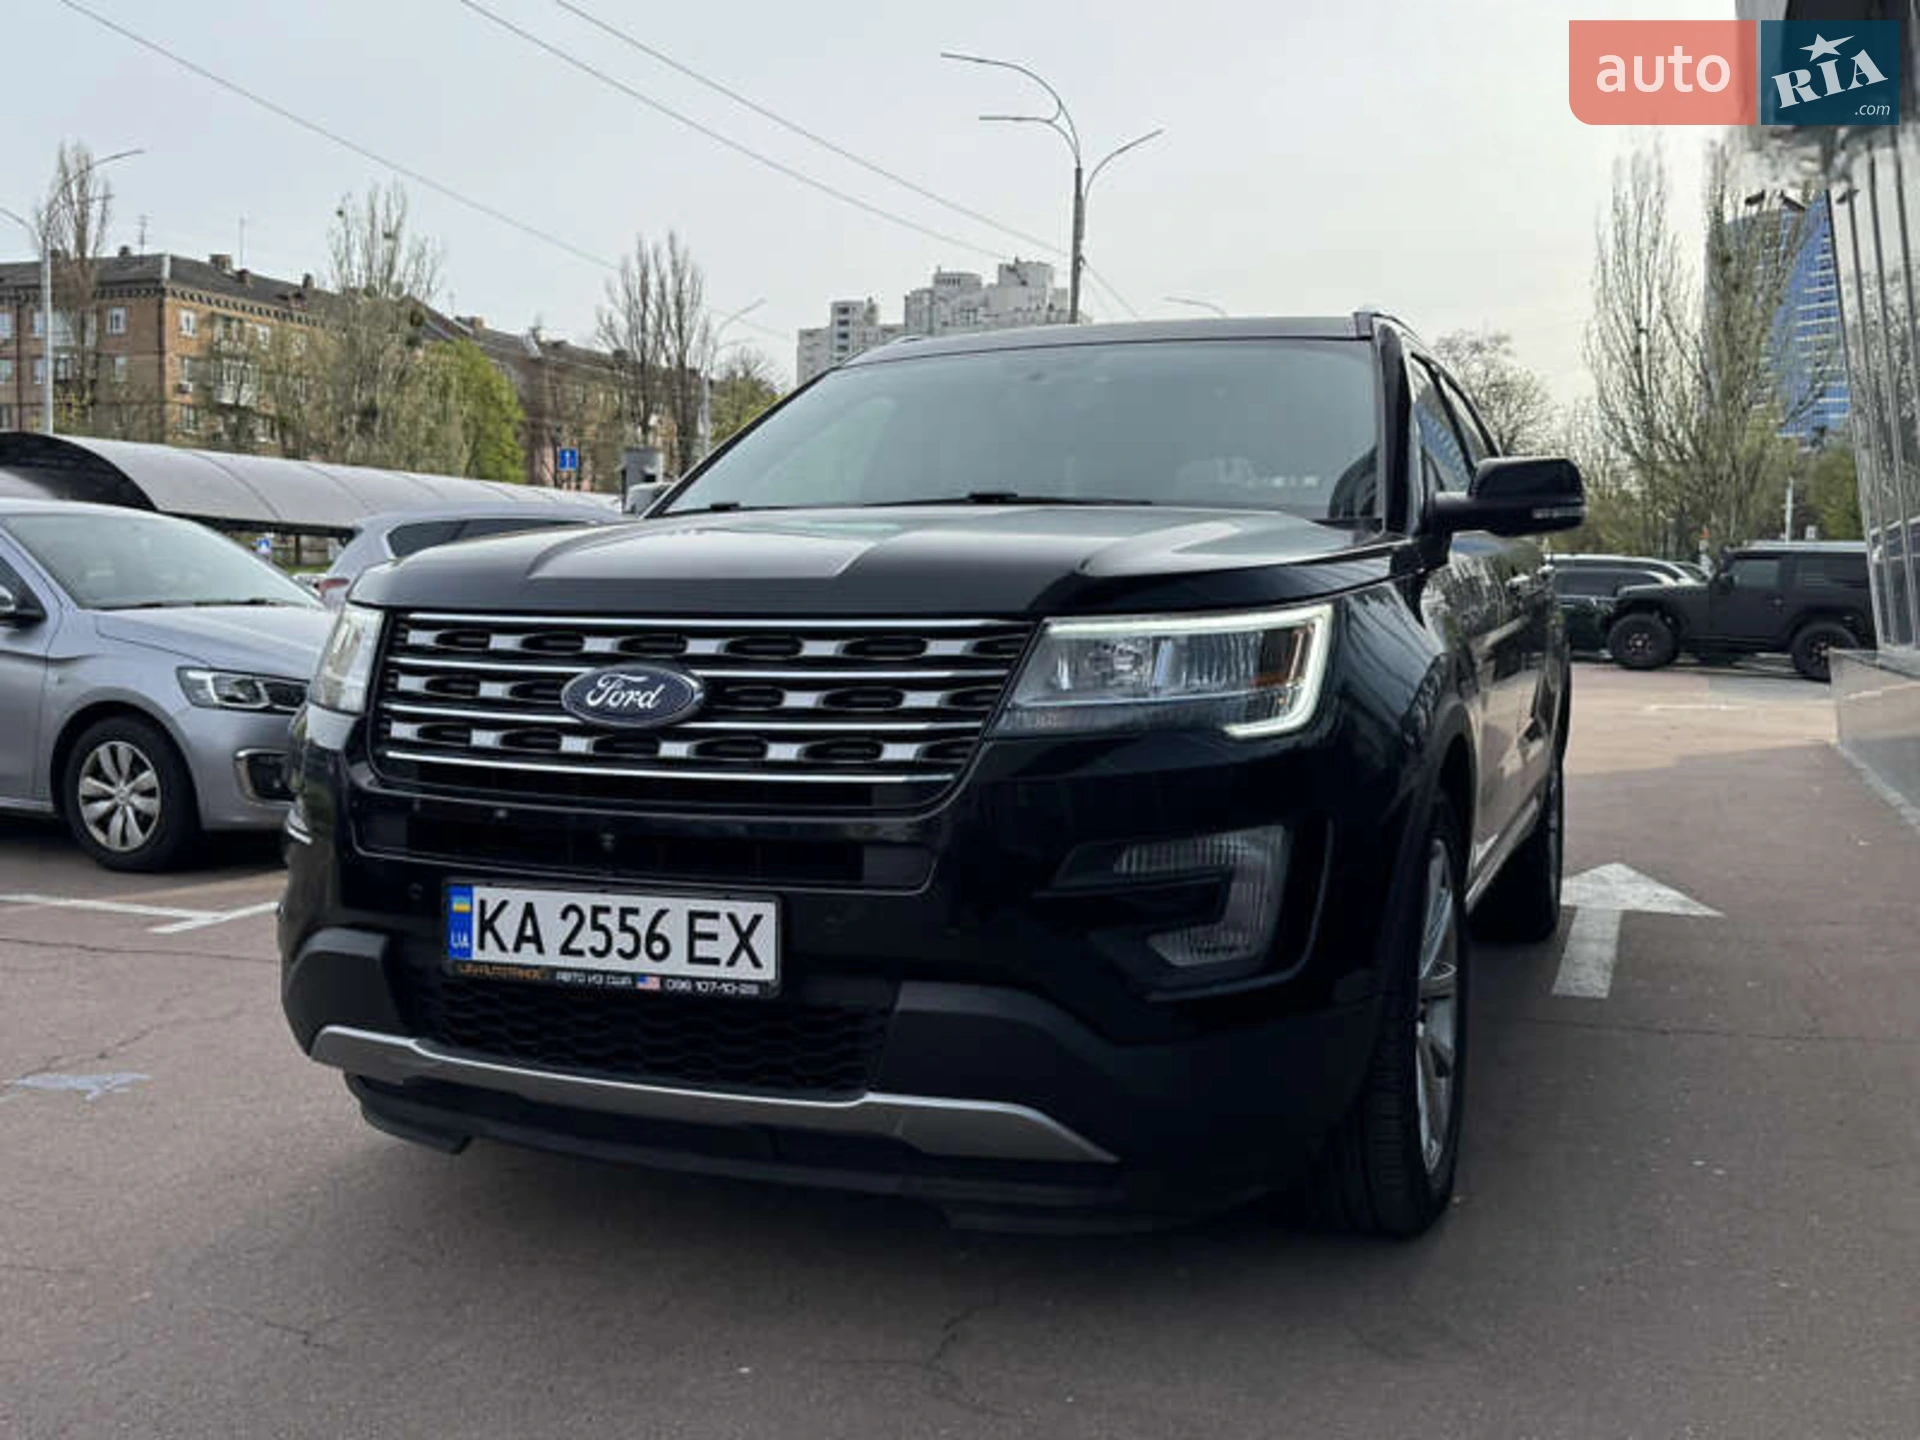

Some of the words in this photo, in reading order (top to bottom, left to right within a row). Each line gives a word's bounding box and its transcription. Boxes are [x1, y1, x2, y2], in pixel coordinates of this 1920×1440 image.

[586, 674, 665, 709] Ford
[450, 930, 470, 949] UA
[477, 899, 545, 955] KA
[559, 903, 671, 962] 2556
[687, 910, 764, 968] EX
